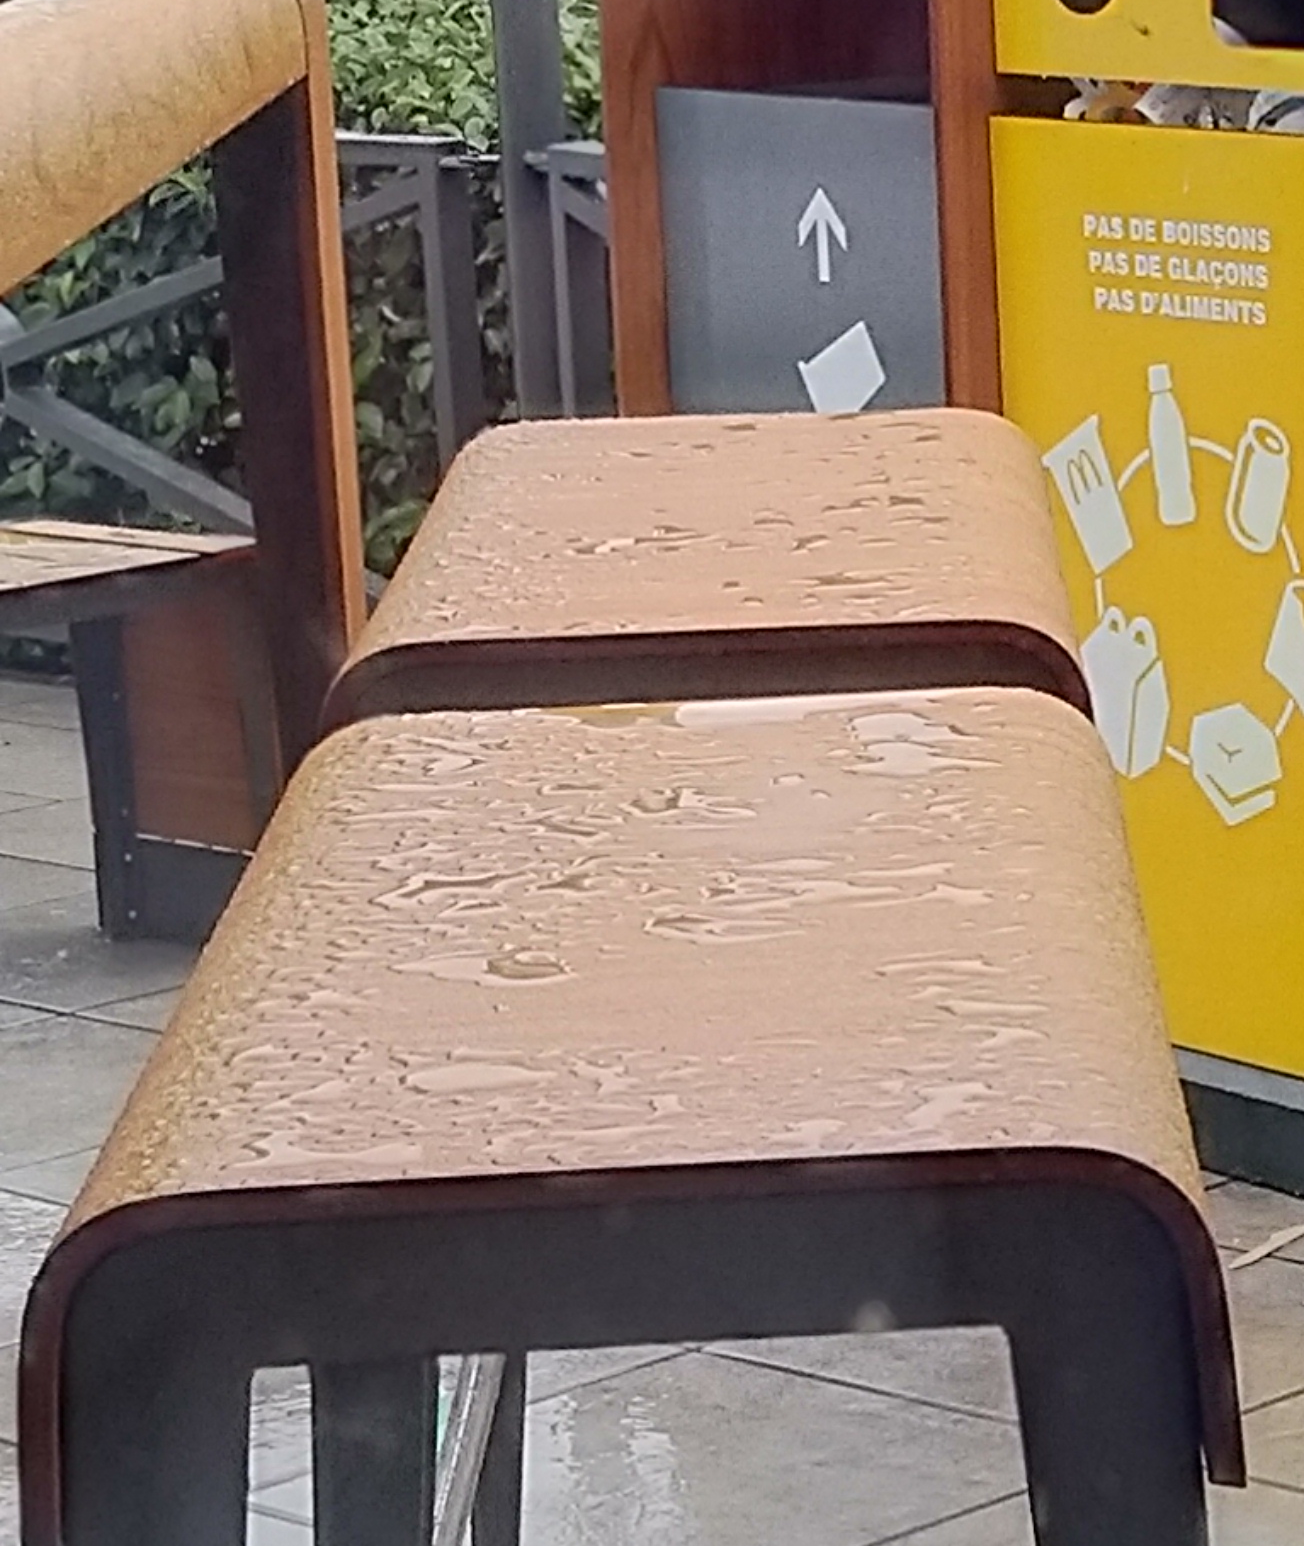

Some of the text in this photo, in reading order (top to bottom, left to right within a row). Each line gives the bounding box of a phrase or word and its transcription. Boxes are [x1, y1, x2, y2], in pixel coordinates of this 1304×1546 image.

[1083, 213, 1271, 253] PAS DE BOISSONS
[1088, 251, 1269, 290] PAS DE GLAÇONS
[1094, 287, 1267, 326] PAS D'ALIMENTS
